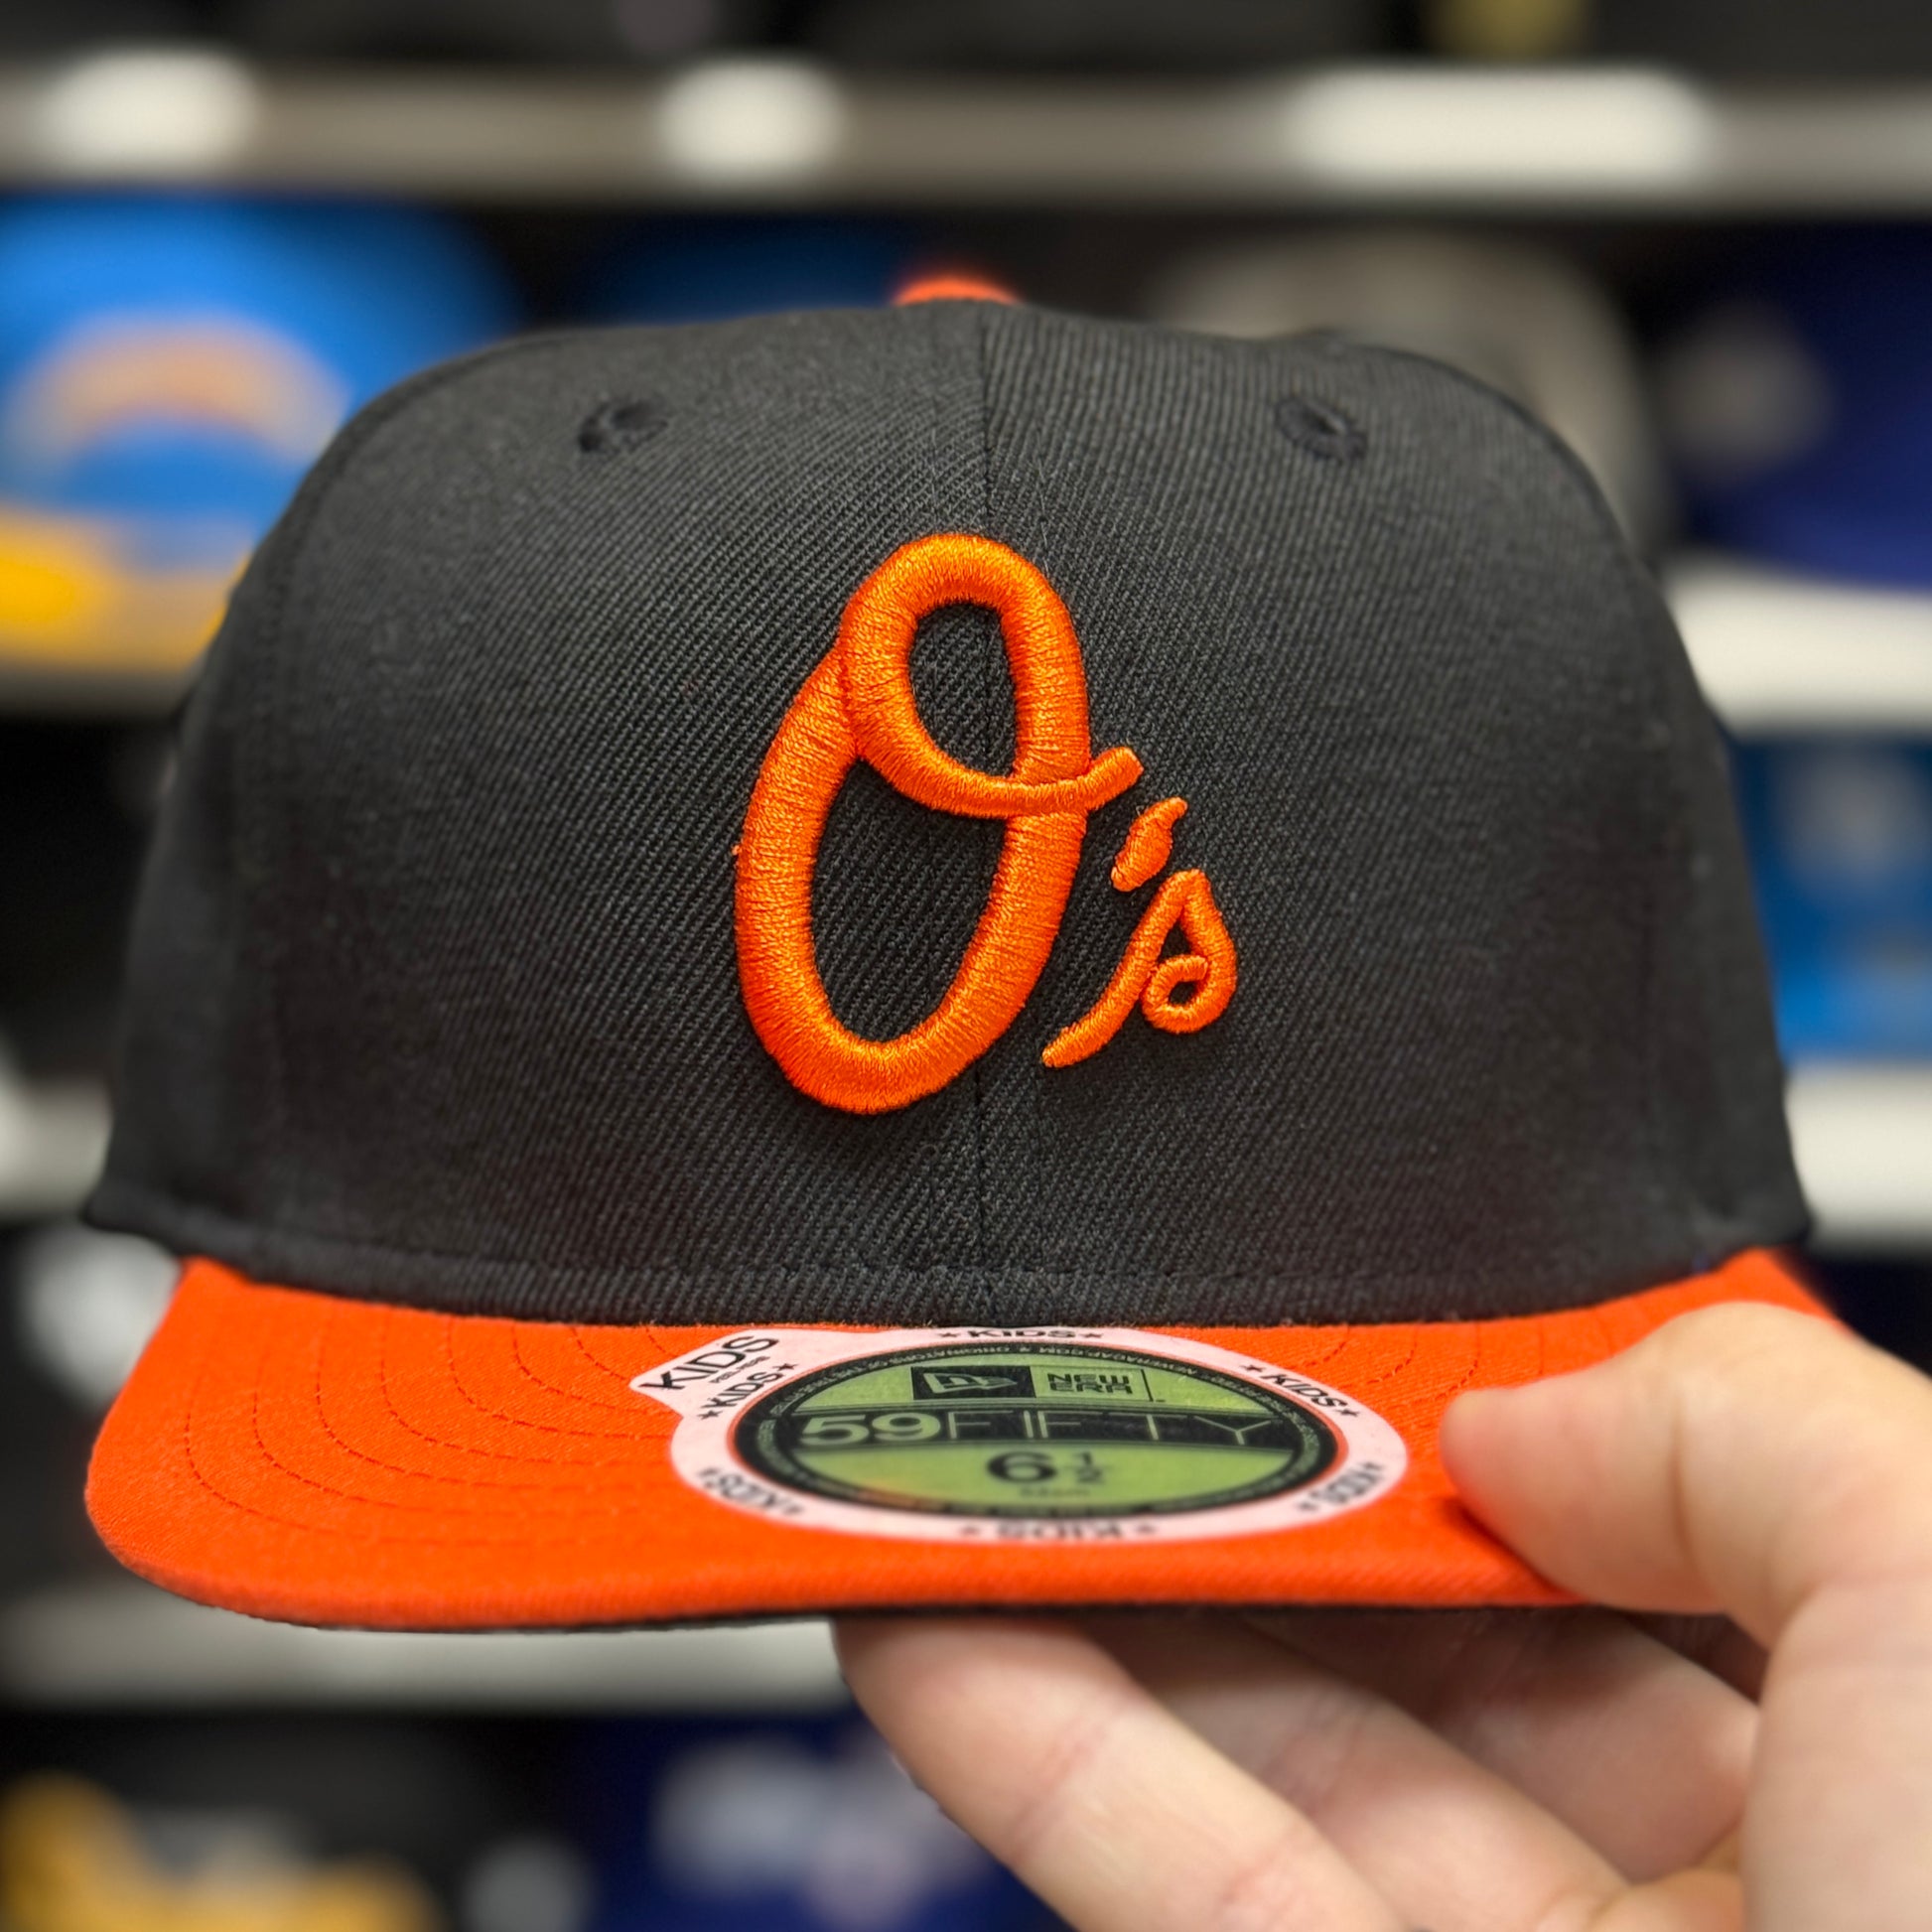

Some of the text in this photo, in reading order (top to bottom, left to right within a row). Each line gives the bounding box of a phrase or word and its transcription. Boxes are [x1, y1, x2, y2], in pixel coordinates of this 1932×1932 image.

[735, 532, 1238, 1114] O's
[967, 1328, 1077, 1339] KIDS
[637, 1335, 780, 1391] KIDS
[1046, 1372, 1131, 1384] NEW
[701, 1371, 786, 1409] KIDS
[1048, 1383, 1134, 1395] ERA
[1259, 1373, 1348, 1408] KIDS
[798, 1410, 1275, 1447] 59FIFTY
[985, 1449, 1059, 1484] 6
